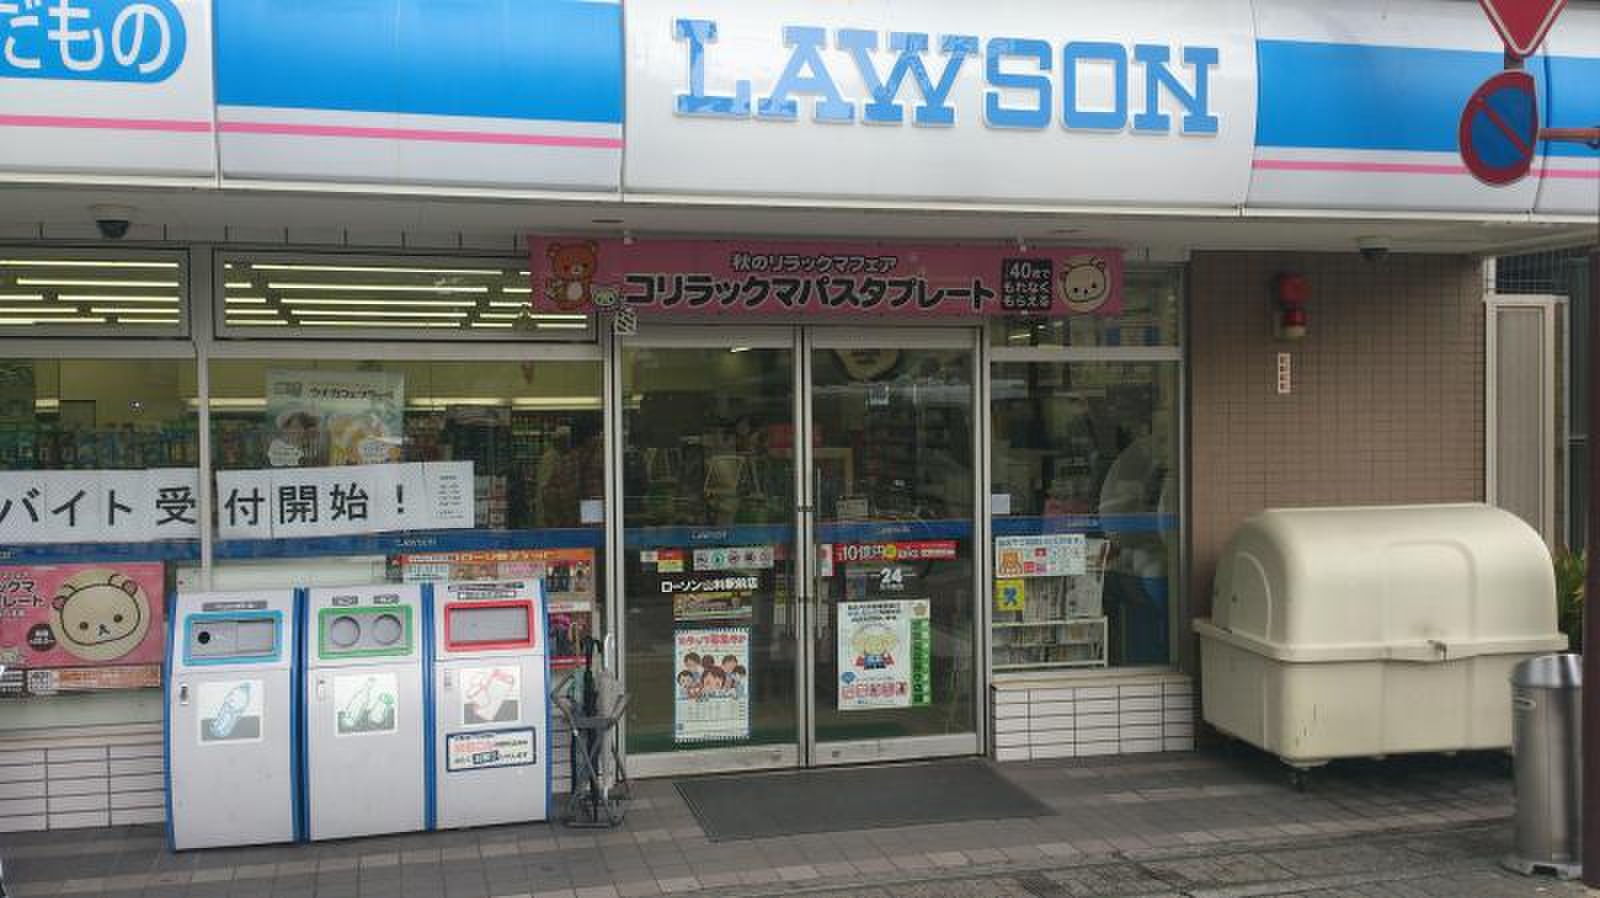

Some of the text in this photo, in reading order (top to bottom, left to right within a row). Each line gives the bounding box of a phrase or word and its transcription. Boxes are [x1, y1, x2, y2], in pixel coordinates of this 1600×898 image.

[673, 17, 1220, 135] LAWSON
[733, 252, 897, 272] 秋のリラックマフェア
[624, 272, 995, 311] コリラックマパスタプレート
[880, 567, 903, 583] 24
[0, 593, 46, 608] レート
